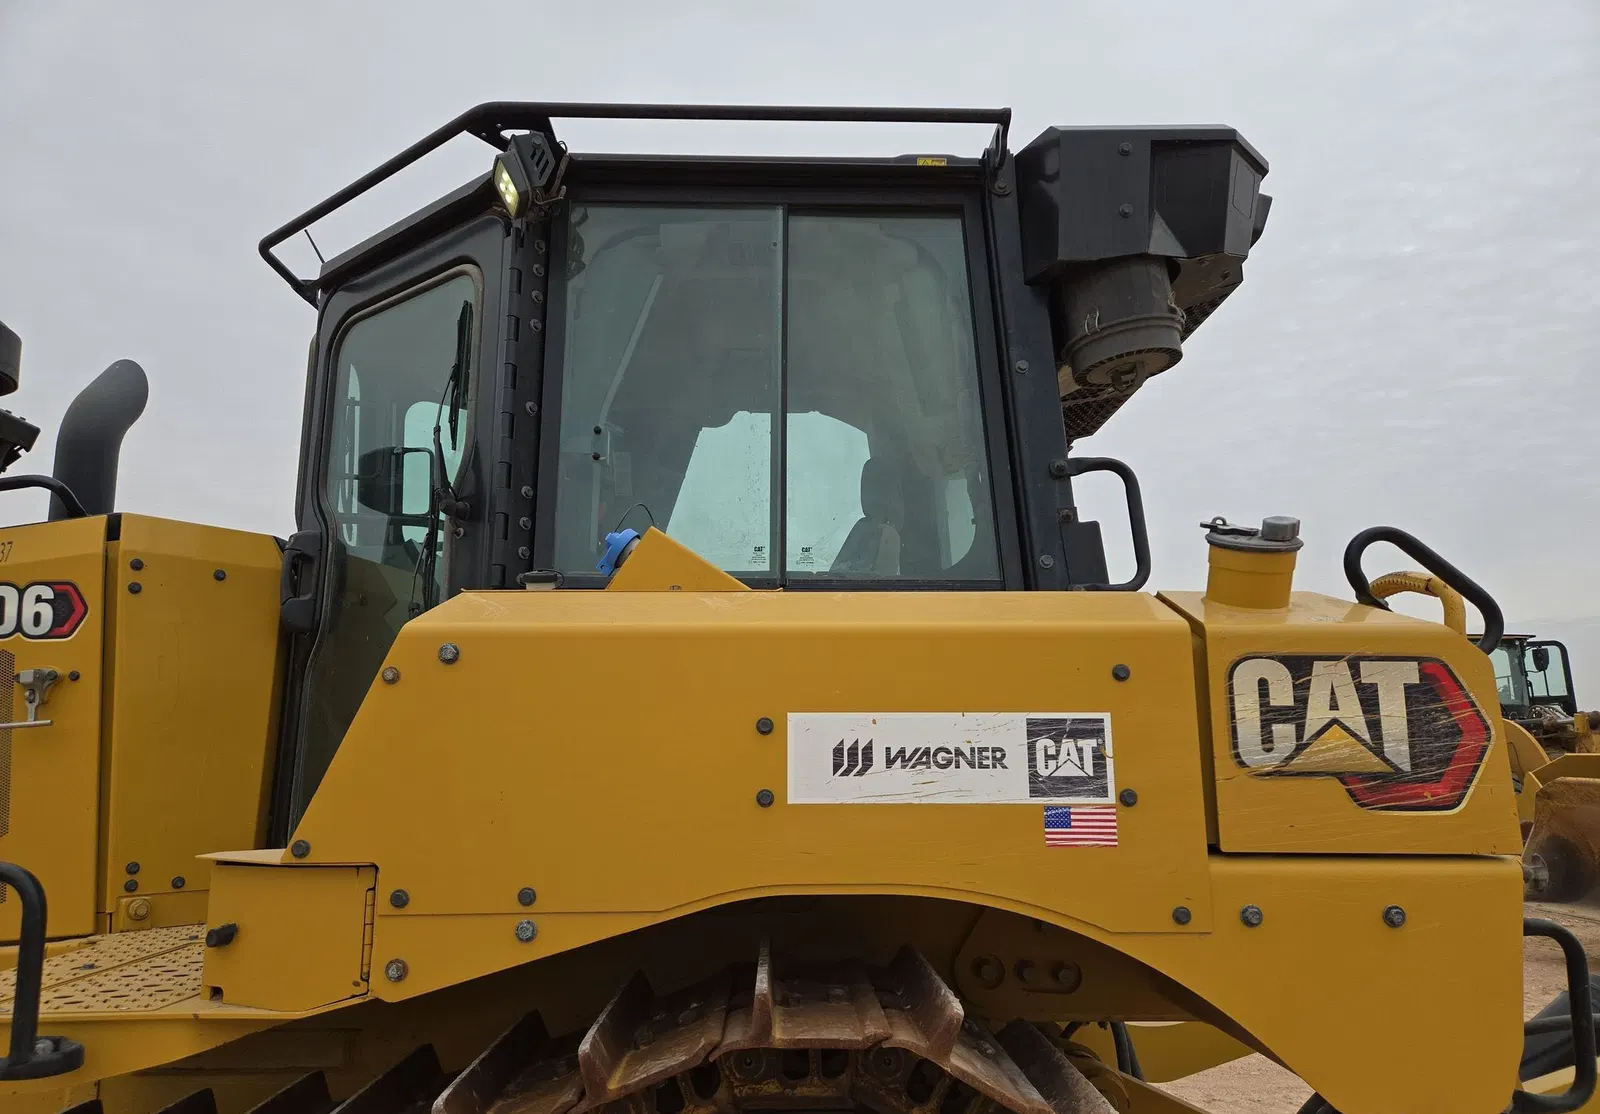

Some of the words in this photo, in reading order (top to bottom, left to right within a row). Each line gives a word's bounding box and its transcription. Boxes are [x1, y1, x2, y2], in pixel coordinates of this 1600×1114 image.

[1232, 658, 1421, 773] CAT
[885, 746, 1009, 770] WAGNER
[1035, 738, 1099, 777] CAT
